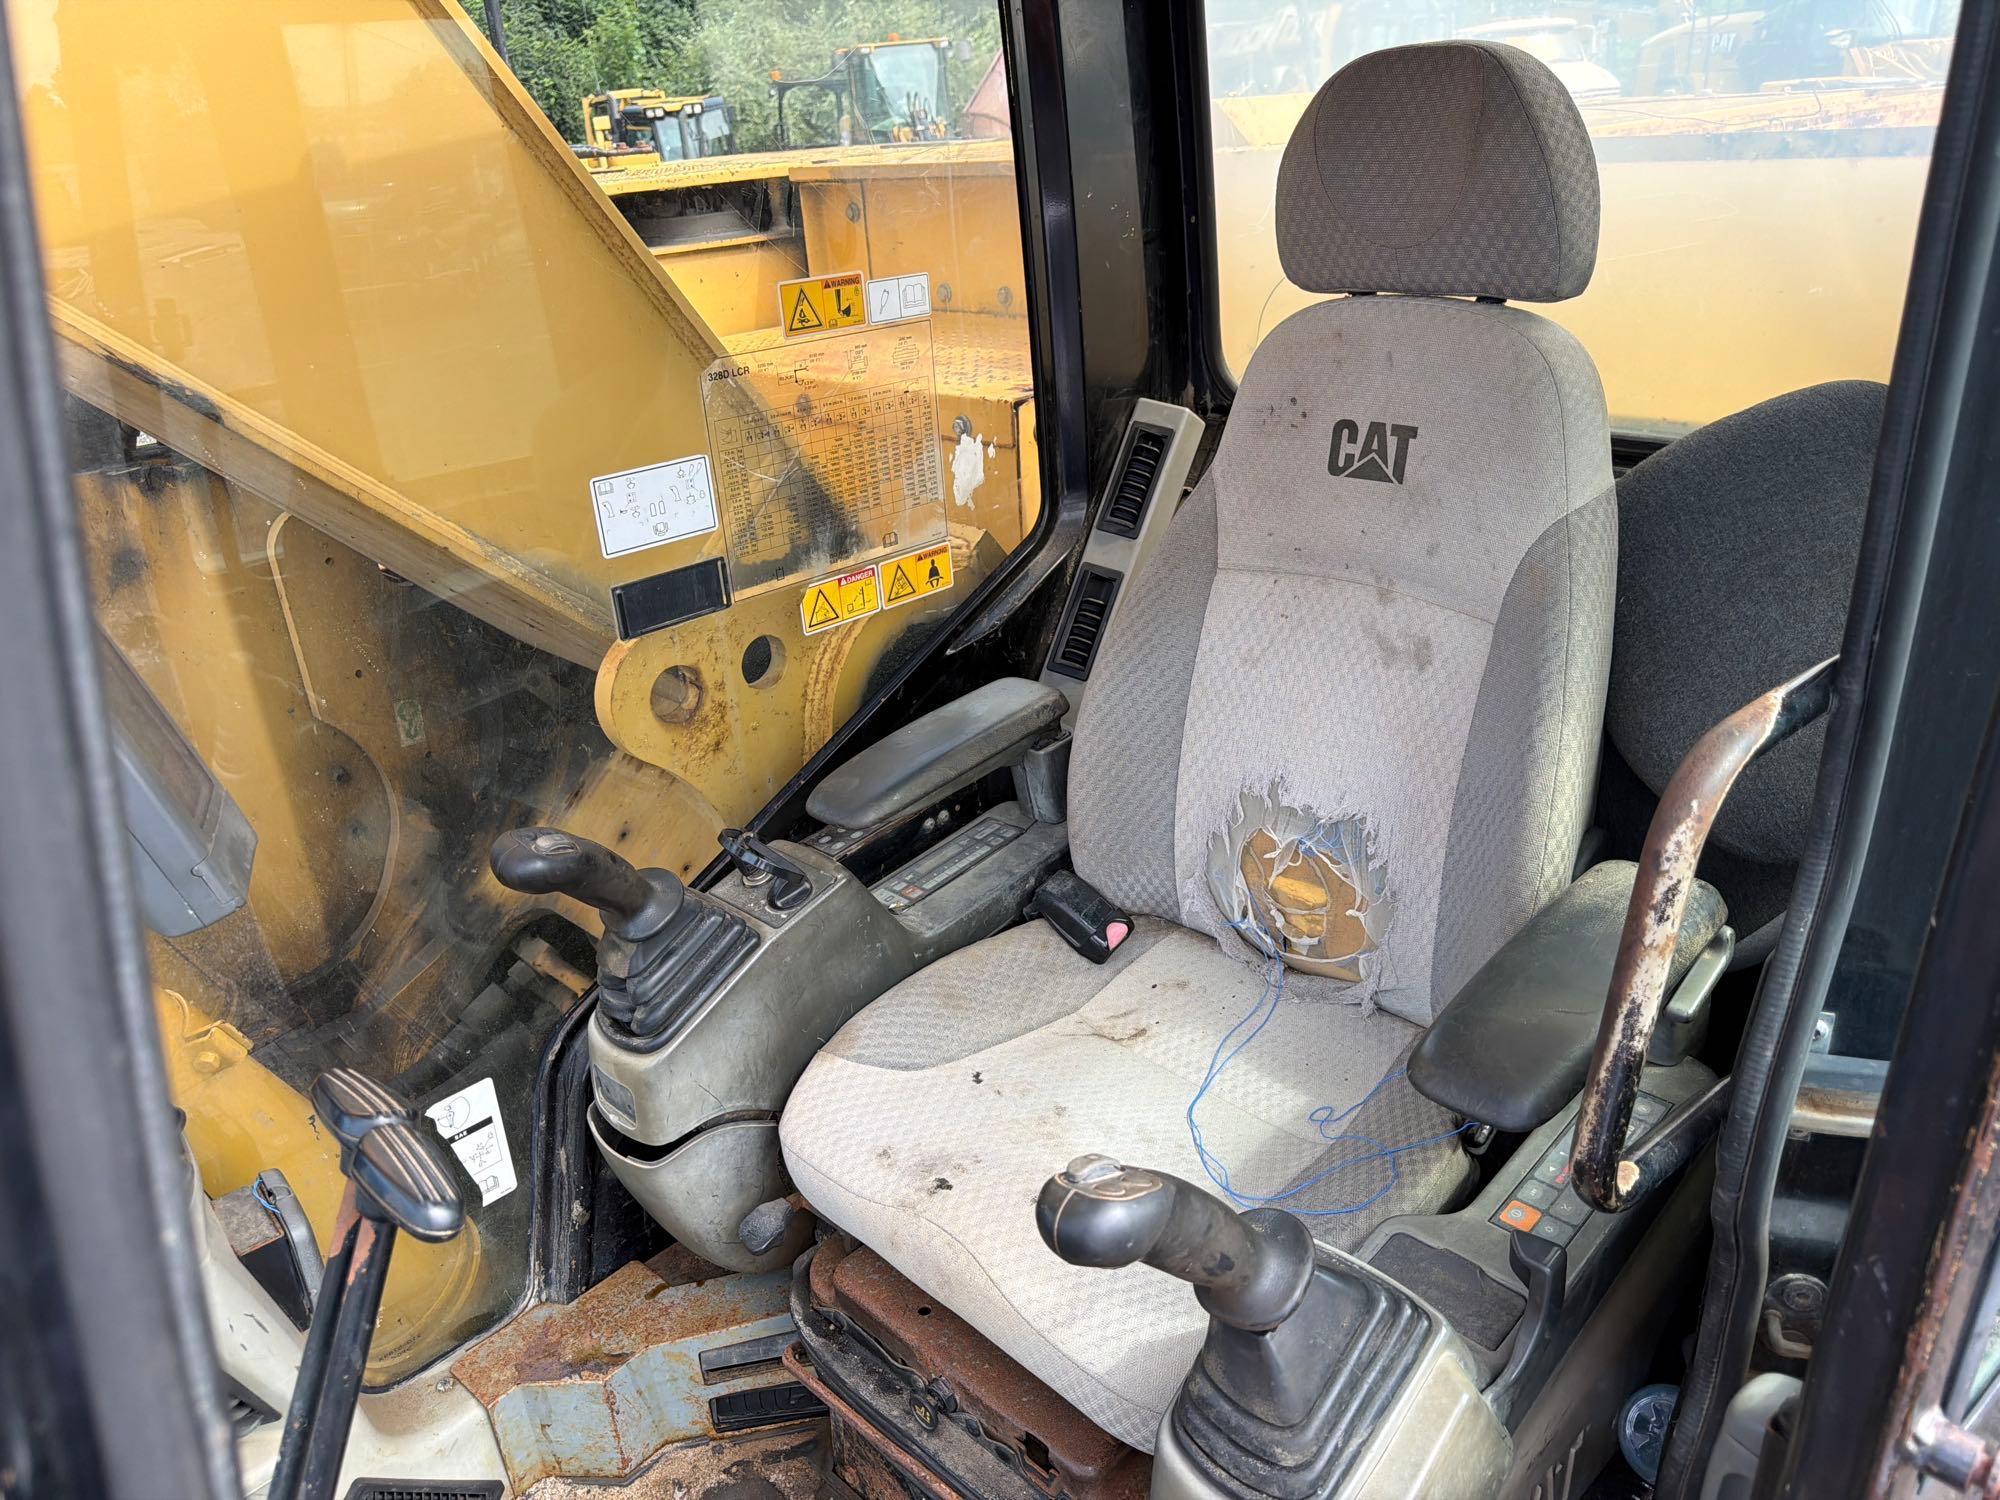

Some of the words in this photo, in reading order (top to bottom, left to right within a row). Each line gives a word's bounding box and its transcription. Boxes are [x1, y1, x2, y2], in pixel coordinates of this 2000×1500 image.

[1711, 32, 1736, 53] CAT
[830, 276, 860, 287] WARNING
[708, 369, 730, 382] 328D
[732, 366, 750, 378] LCR
[1328, 419, 1418, 484] CAT
[923, 547, 948, 560] WARNING
[846, 570, 873, 583] DANGER
